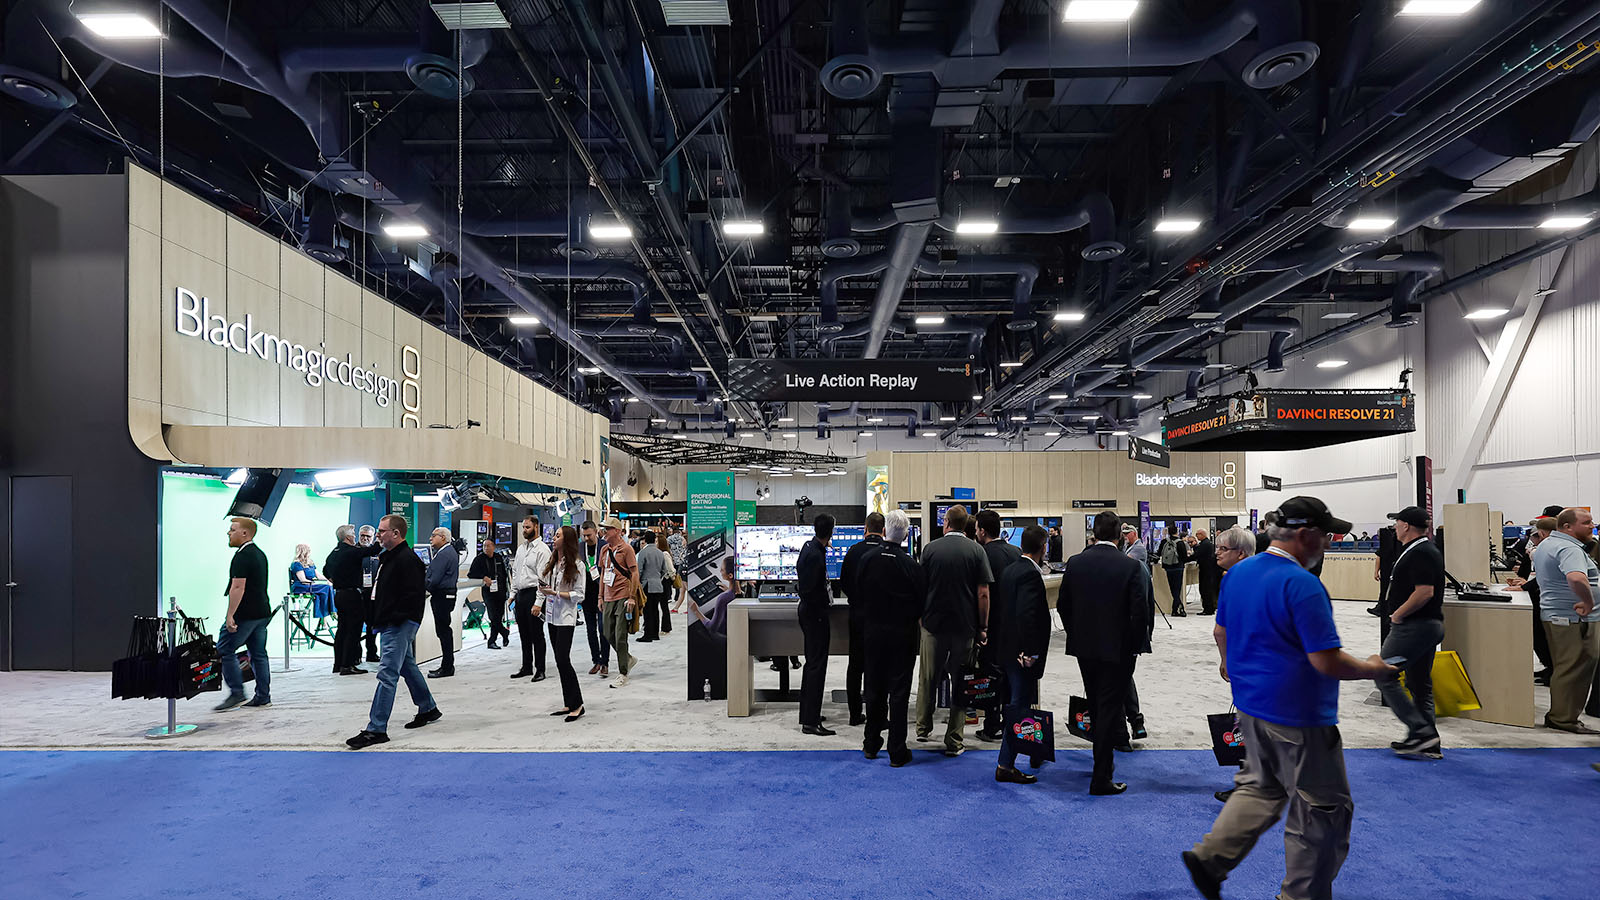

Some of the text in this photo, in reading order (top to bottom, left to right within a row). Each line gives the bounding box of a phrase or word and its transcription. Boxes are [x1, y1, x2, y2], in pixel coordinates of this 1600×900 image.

[175, 286, 399, 408] Blackmagicdesign
[785, 373, 918, 390] Live Action Replay
[1277, 408, 1395, 420] DAVINCI RESOLVE 21
[1167, 425, 1191, 440] DAVINCI
[1190, 418, 1218, 434] RESOLVE
[1218, 415, 1227, 427] 21
[534, 461, 563, 477] Ultimatte 12
[1136, 473, 1223, 489] Blackmagicdesign
